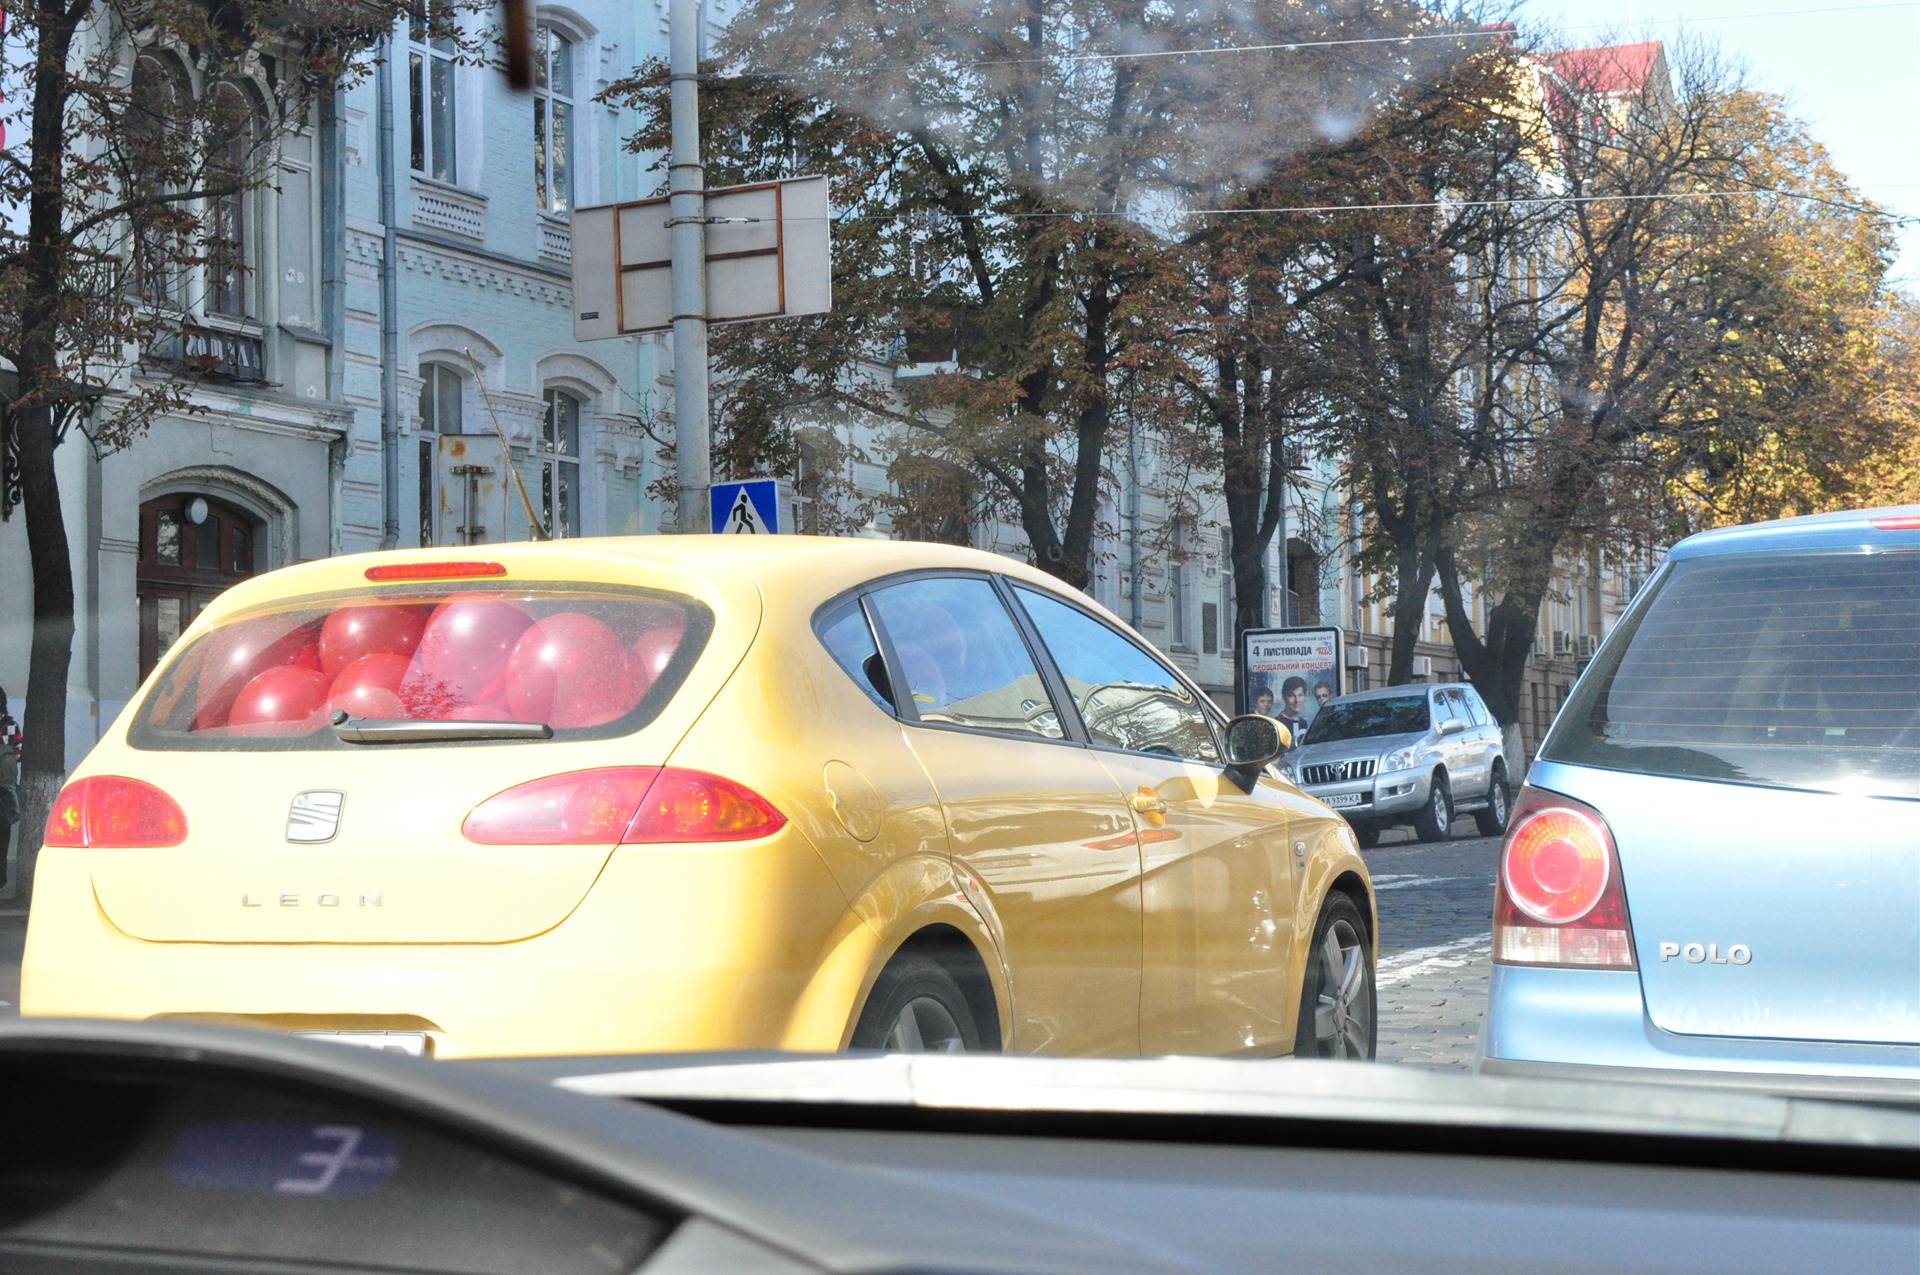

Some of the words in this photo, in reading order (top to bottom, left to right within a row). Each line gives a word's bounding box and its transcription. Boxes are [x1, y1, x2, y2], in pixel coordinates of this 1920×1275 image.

[1252, 645, 1260, 657] 4
[1263, 646, 1312, 657] ЛИСТОПАДА
[1252, 662, 1300, 672] ПРОЩАЛЬНИЙ
[1301, 661, 1333, 670] КОНЦЕРТ
[242, 893, 382, 907] LEON
[1660, 942, 1752, 966] POLO
[275, 1124, 363, 1194] 3
